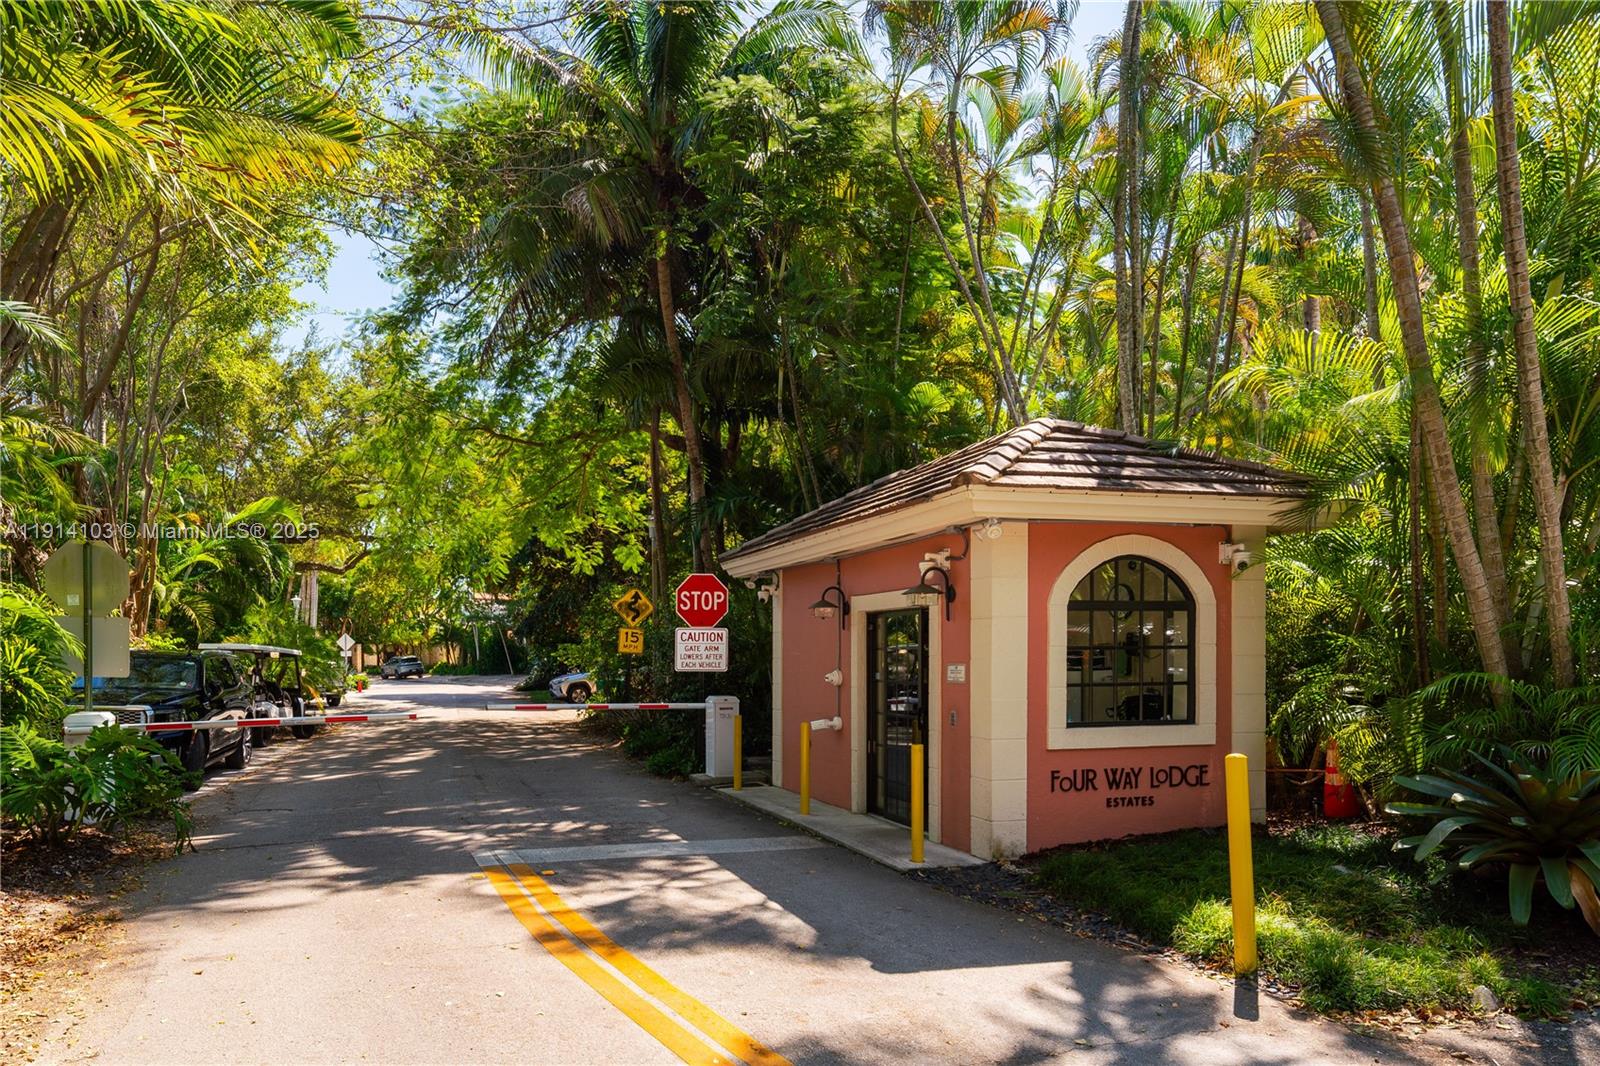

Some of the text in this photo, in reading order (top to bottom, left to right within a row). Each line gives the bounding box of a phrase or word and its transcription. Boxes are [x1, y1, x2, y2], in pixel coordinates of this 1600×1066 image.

[679, 590, 725, 611] STOP
[624, 631, 640, 643] 15
[680, 631, 724, 642] CAUTION
[1105, 796, 1155, 808] ESTATES
